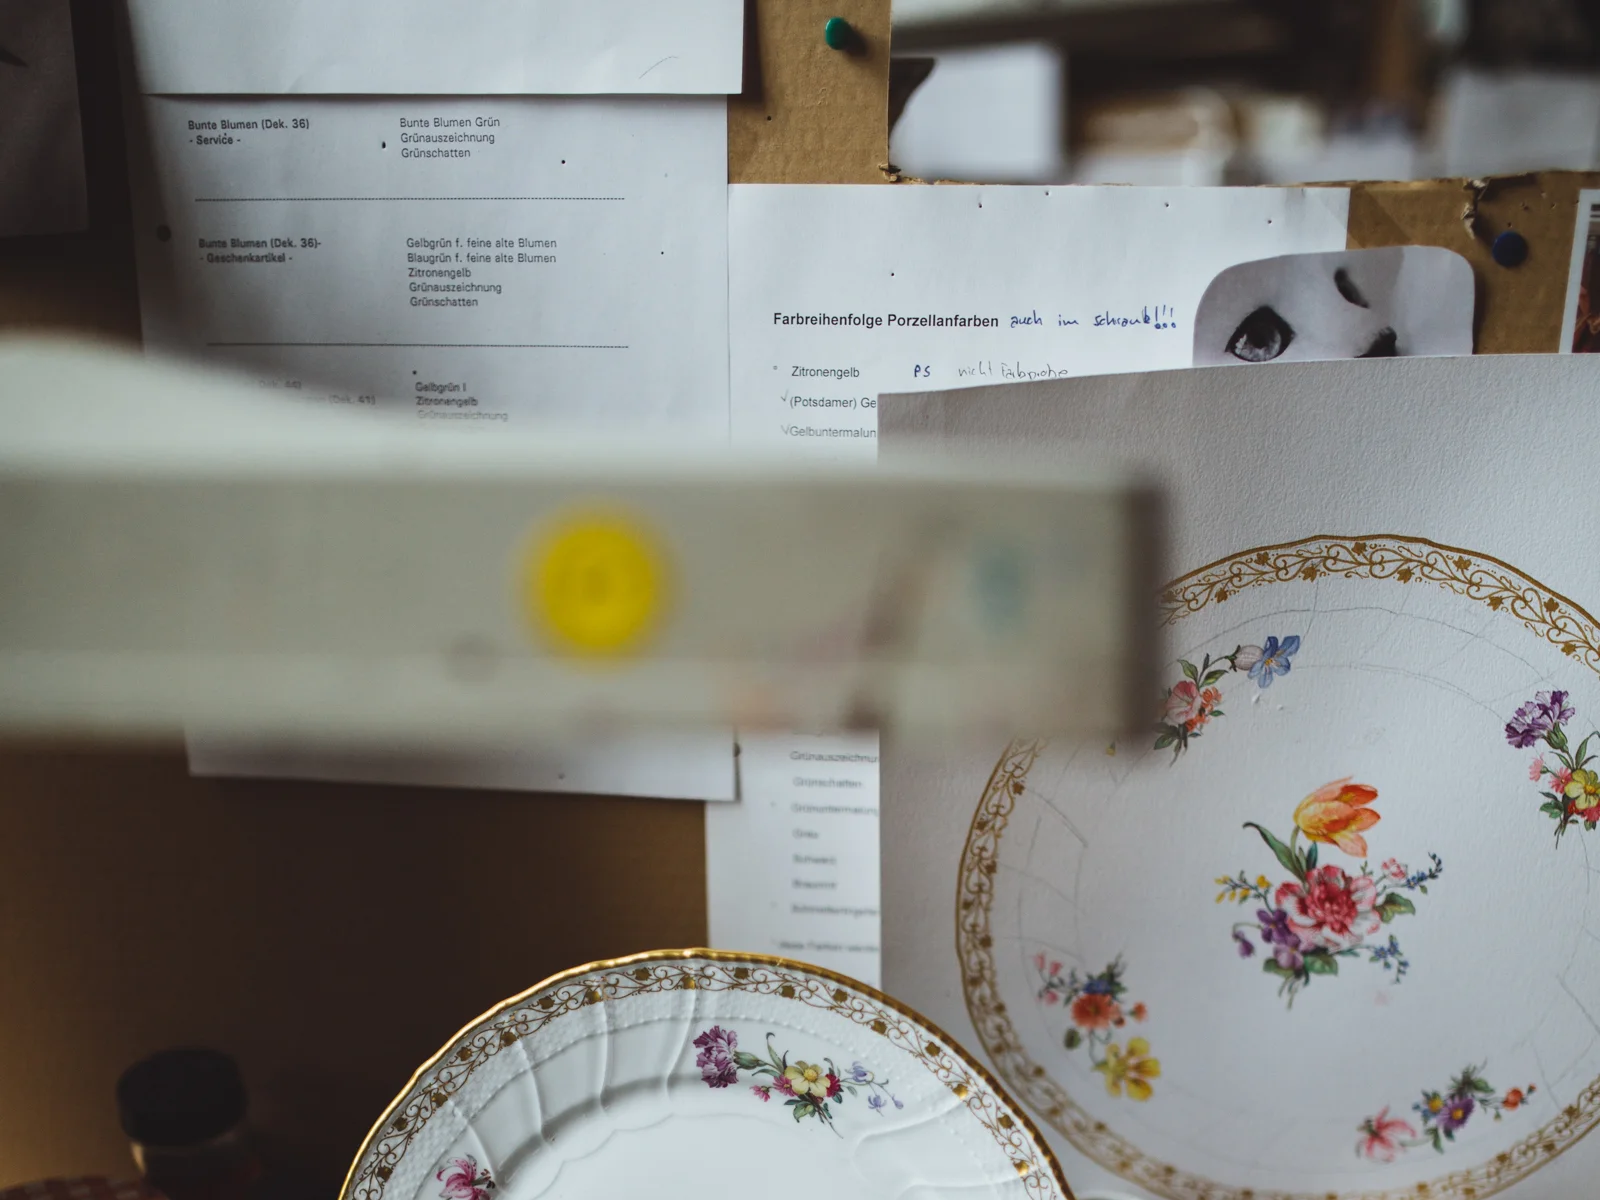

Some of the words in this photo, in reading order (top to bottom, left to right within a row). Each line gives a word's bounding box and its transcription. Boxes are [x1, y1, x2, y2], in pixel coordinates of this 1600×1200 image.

[188, 119, 217, 130] Bunte
[220, 118, 258, 129] Blumen
[261, 119, 288, 130] (Dek.
[292, 118, 310, 129] 36)
[400, 117, 430, 128] Bunte
[433, 117, 472, 127] Blumen
[475, 116, 500, 127] Grün
[196, 134, 233, 145] Service
[400, 132, 495, 144] Grünauszeichnung
[401, 147, 471, 158] Grünschatten
[199, 238, 228, 249] Bunte
[230, 238, 267, 248] Blumen
[270, 238, 297, 249] (Dek.
[406, 237, 452, 250] Gelbgrün
[455, 237, 463, 248] f.
[466, 237, 492, 248] feine
[495, 237, 515, 248] alte
[518, 237, 557, 248] Blumen
[206, 252, 286, 263] Geschenkartikel
[407, 252, 452, 265] Blaugrün
[455, 252, 462, 263] f.
[466, 252, 491, 263] feine
[495, 252, 514, 263] alte
[517, 252, 557, 263] Blumen
[408, 267, 472, 279] Zitronengelb
[409, 282, 502, 294] Grünauszeichnung
[409, 296, 479, 307] Grünschatten
[773, 312, 883, 329] Farbreihenfolge
[887, 313, 999, 328] Porzellanfarben
[1010, 309, 1043, 328] auch
[1058, 314, 1079, 327] im
[791, 365, 860, 380] Zitronengelb
[415, 382, 460, 394] Gelbgrün
[415, 396, 479, 408] Zitronengelb
[790, 396, 857, 410] (Potsdamer)
[860, 397, 877, 408] Ge
[789, 425, 877, 438] Gelbuntermalun
